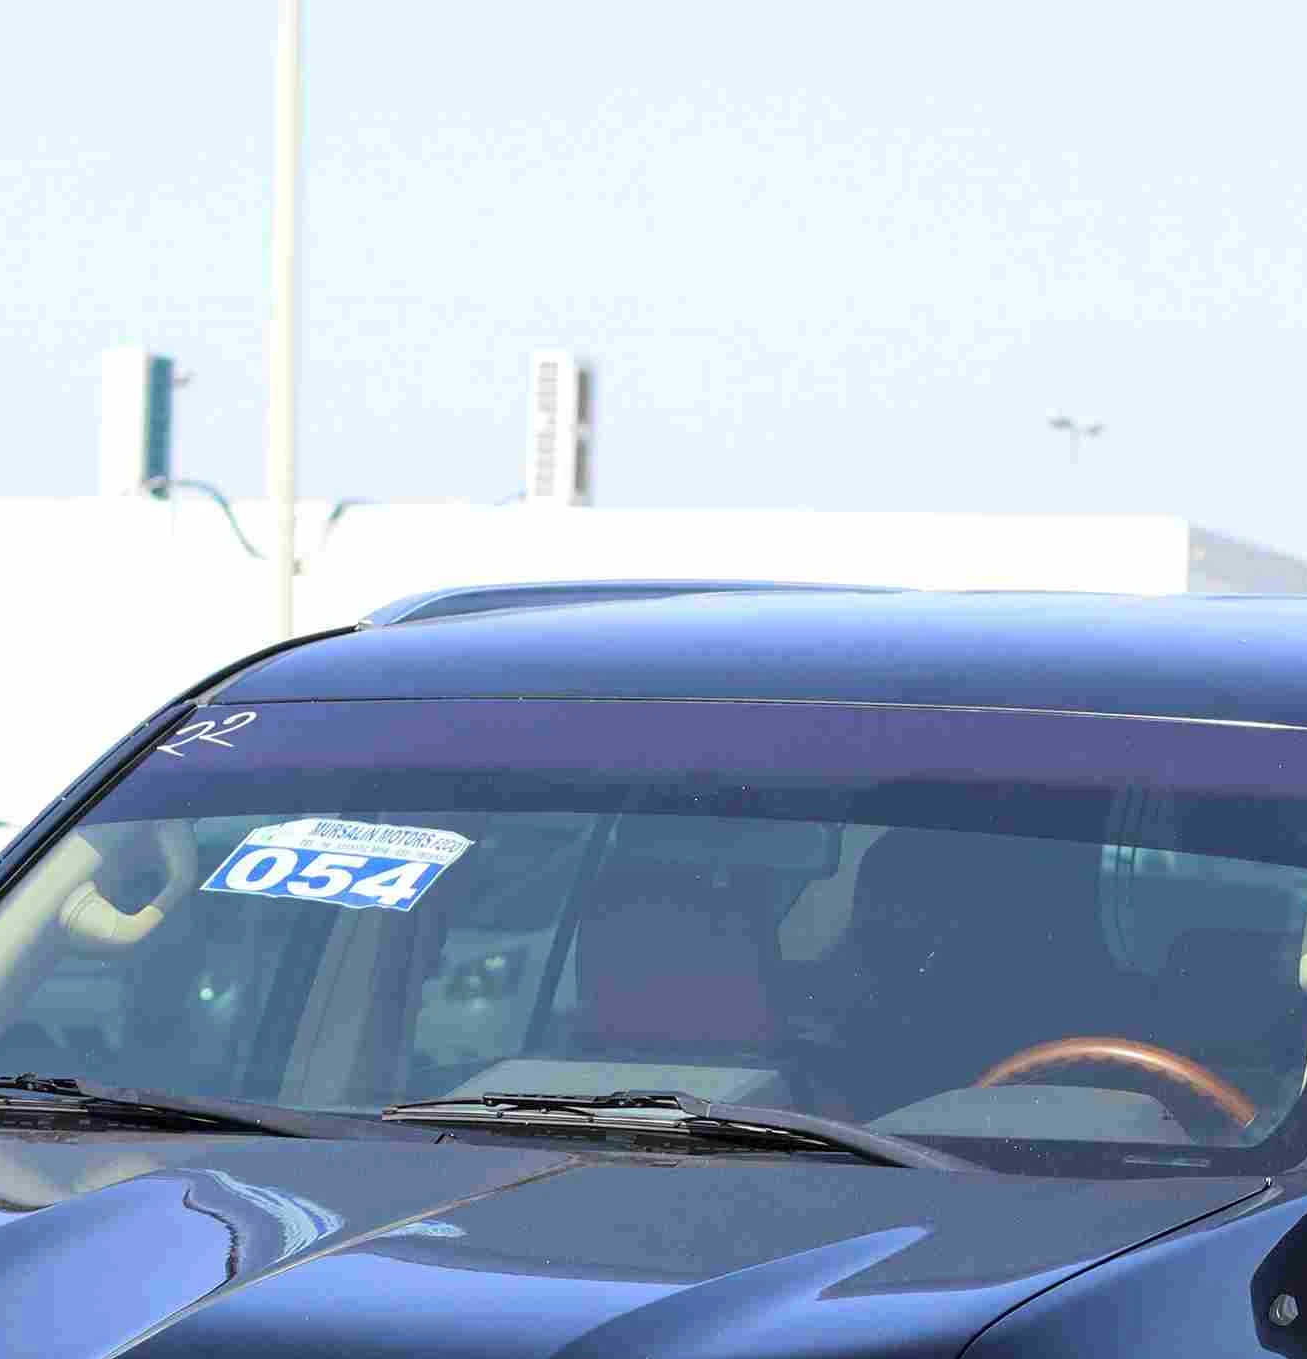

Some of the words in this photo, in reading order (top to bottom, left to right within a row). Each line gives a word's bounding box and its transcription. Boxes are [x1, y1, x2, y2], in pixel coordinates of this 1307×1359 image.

[156, 711, 257, 757] 22
[378, 827, 436, 849] MOTORS
[225, 848, 430, 905] 054
